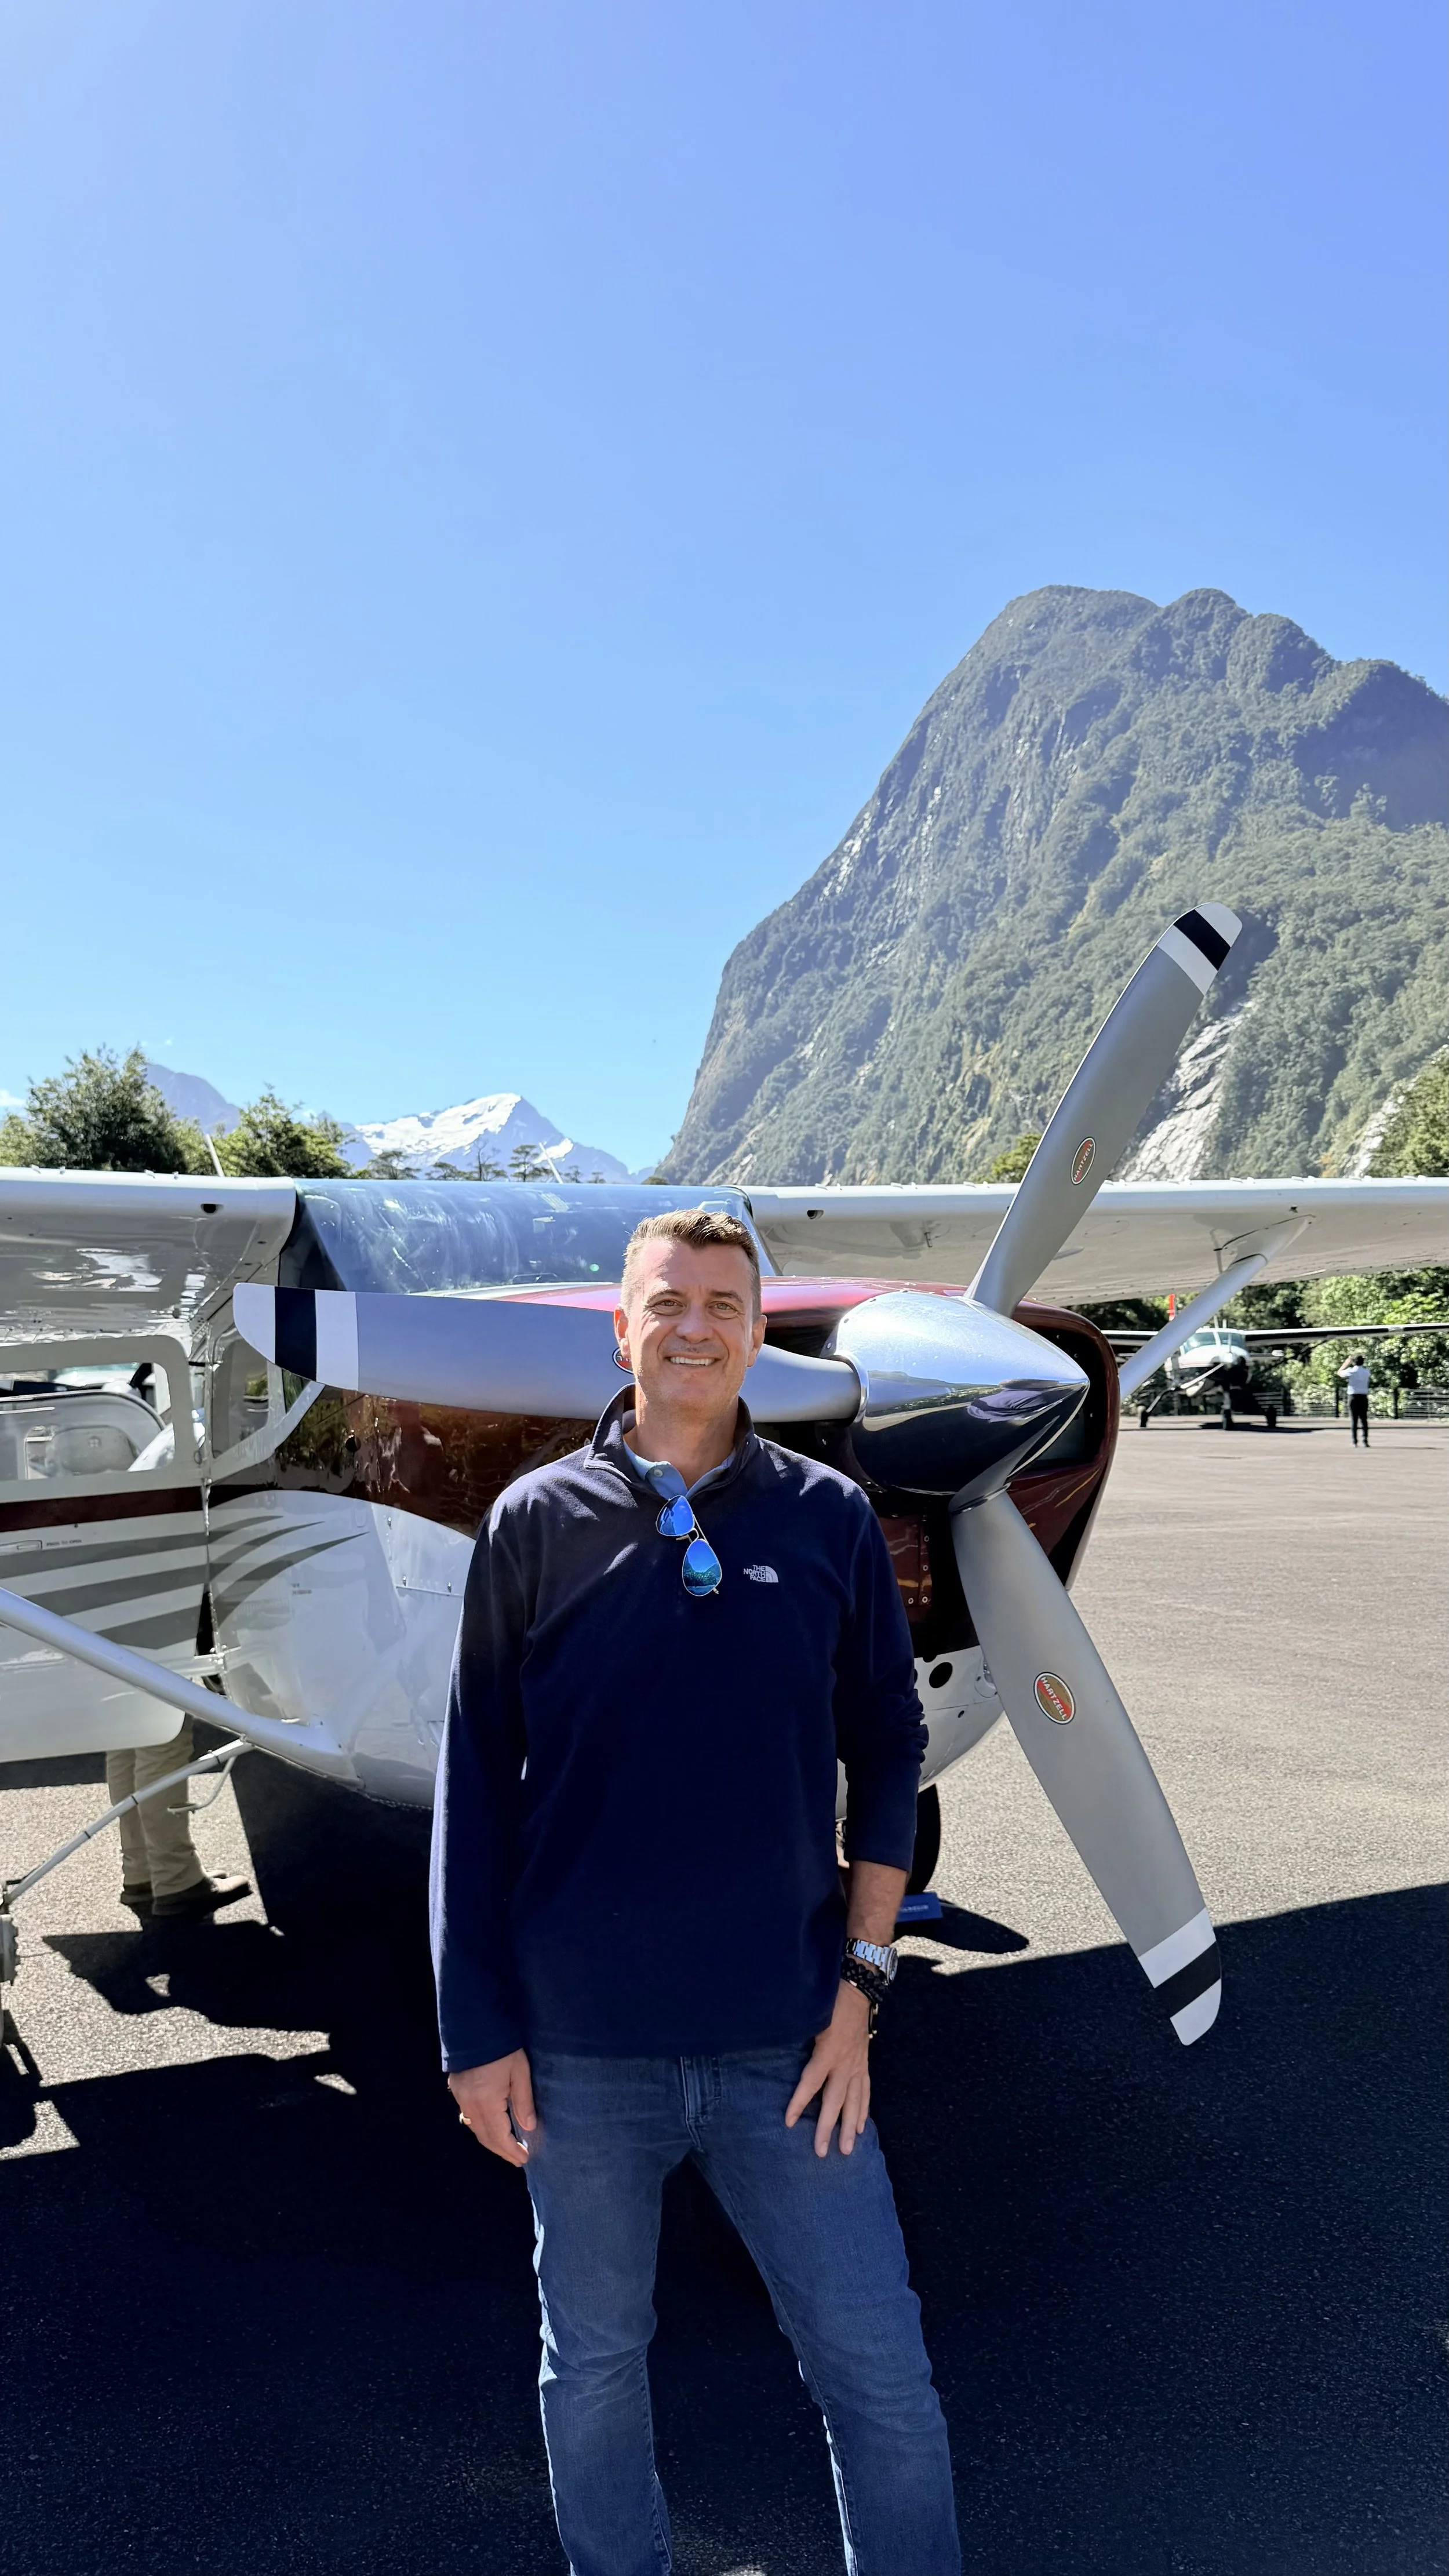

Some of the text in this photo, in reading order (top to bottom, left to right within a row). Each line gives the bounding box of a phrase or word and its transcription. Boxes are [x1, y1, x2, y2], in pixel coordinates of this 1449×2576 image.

[1074, 1143, 1093, 1181] HARTZELL
[743, 1568, 766, 1577] NORTH
[1040, 1676, 1068, 1720] HARTZELL
